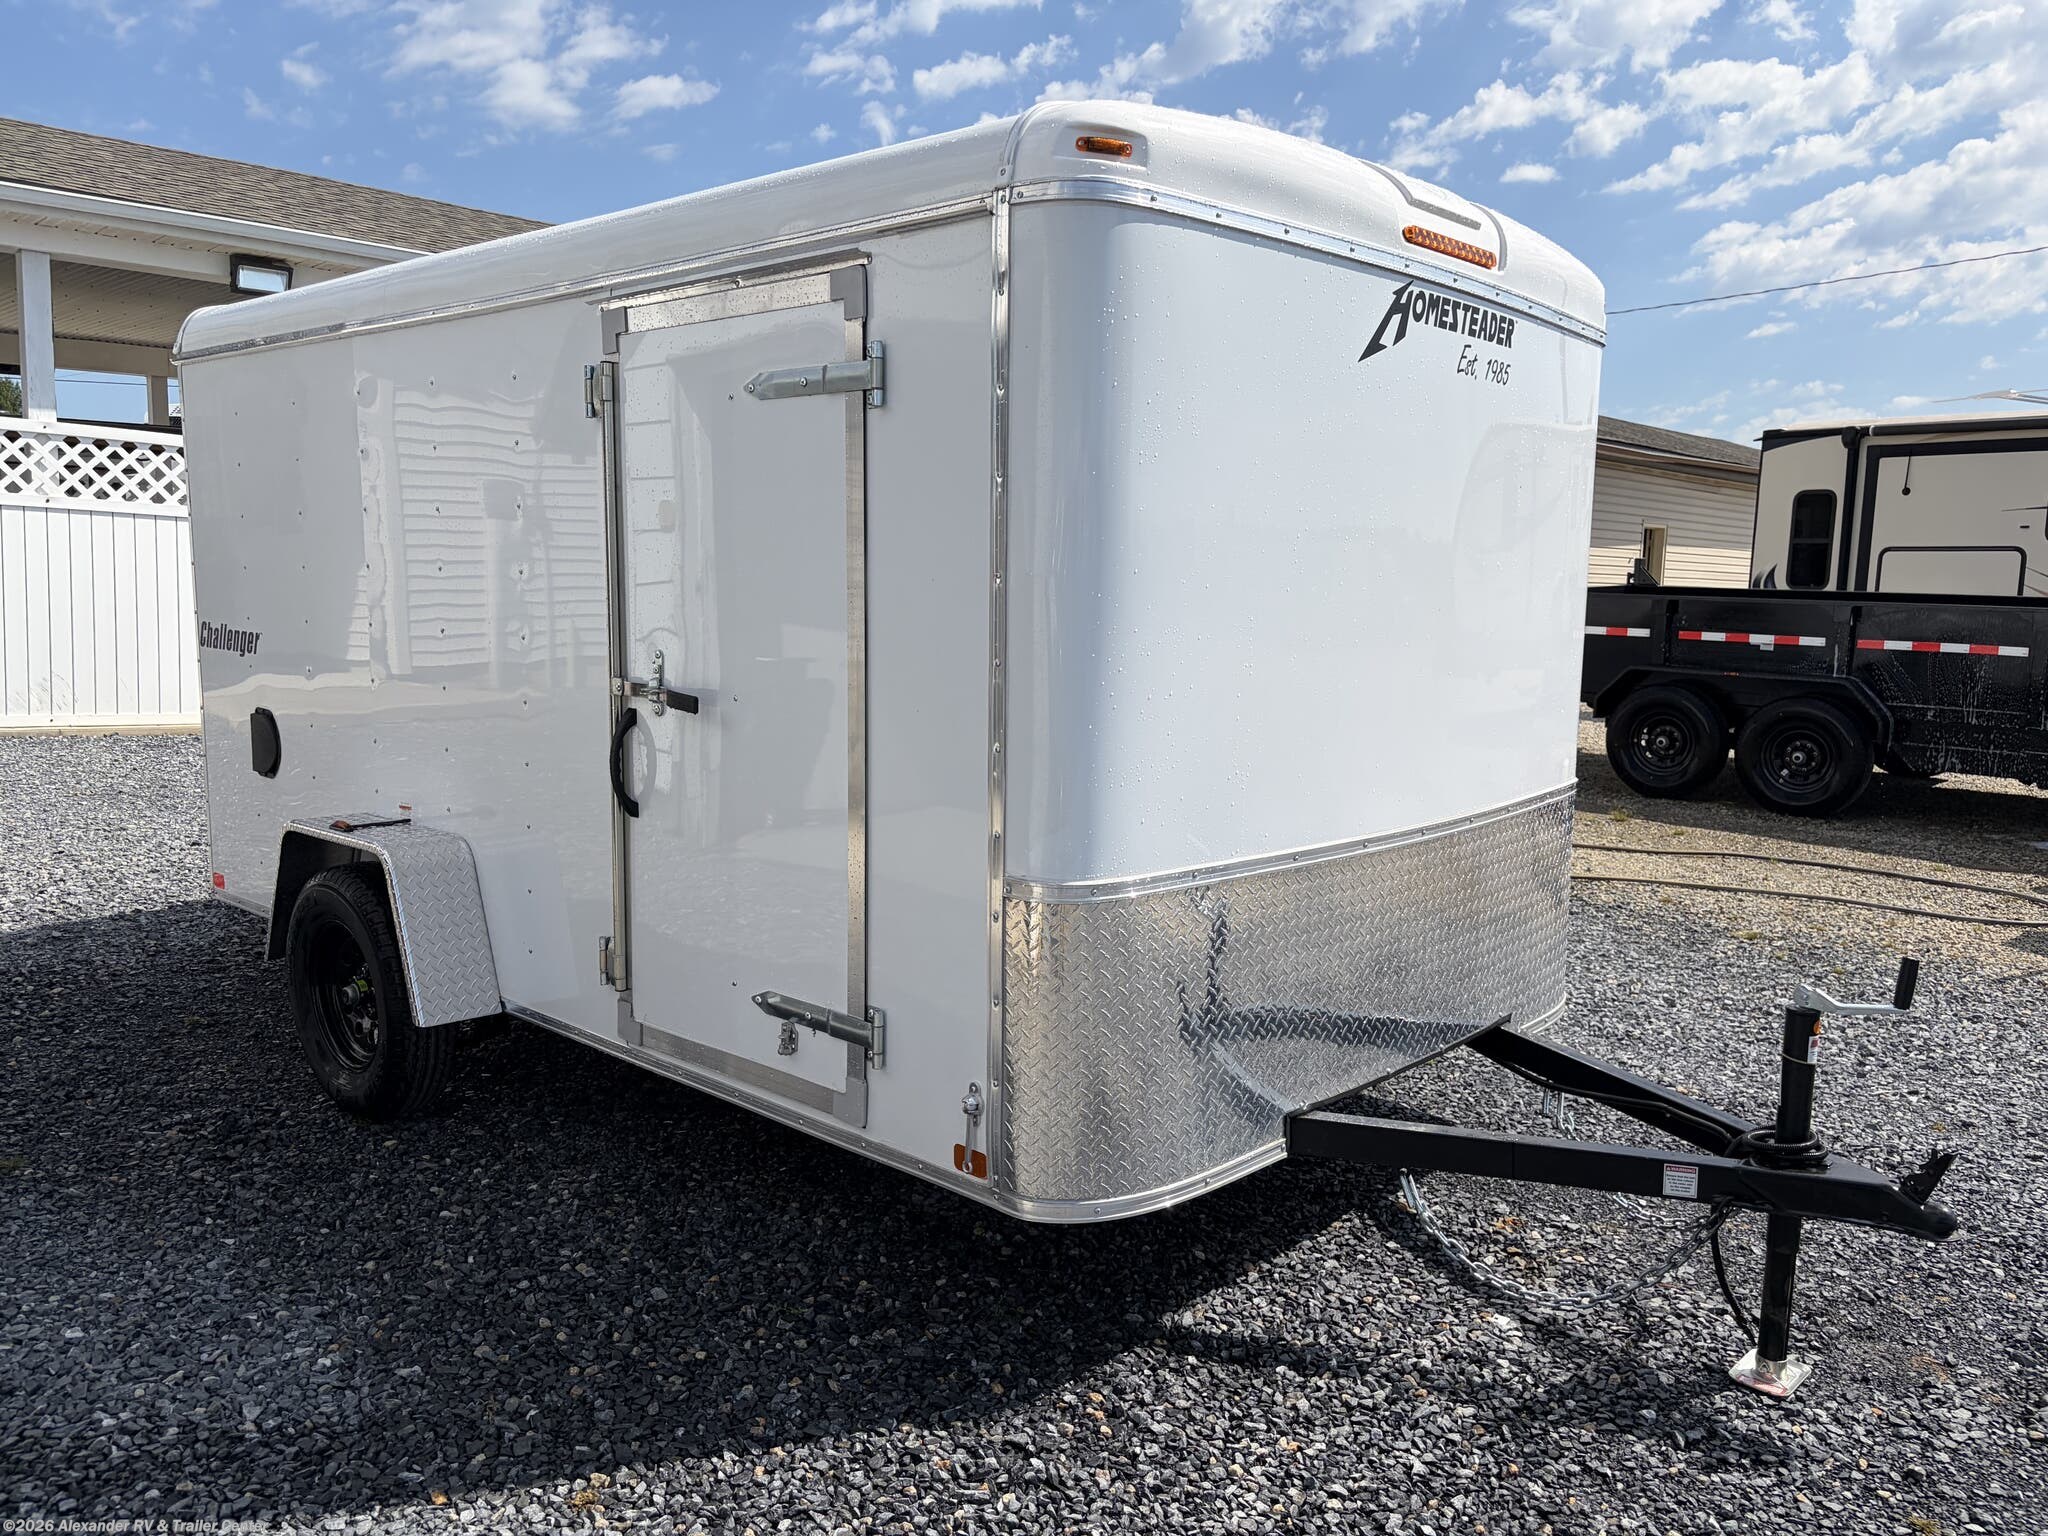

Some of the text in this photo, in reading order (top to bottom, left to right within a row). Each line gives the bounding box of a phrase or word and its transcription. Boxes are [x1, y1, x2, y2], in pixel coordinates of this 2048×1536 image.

[1358, 280, 1515, 362] HOMESTEADER
[1485, 358, 1511, 385] 1985
[200, 621, 261, 657] Challenger
